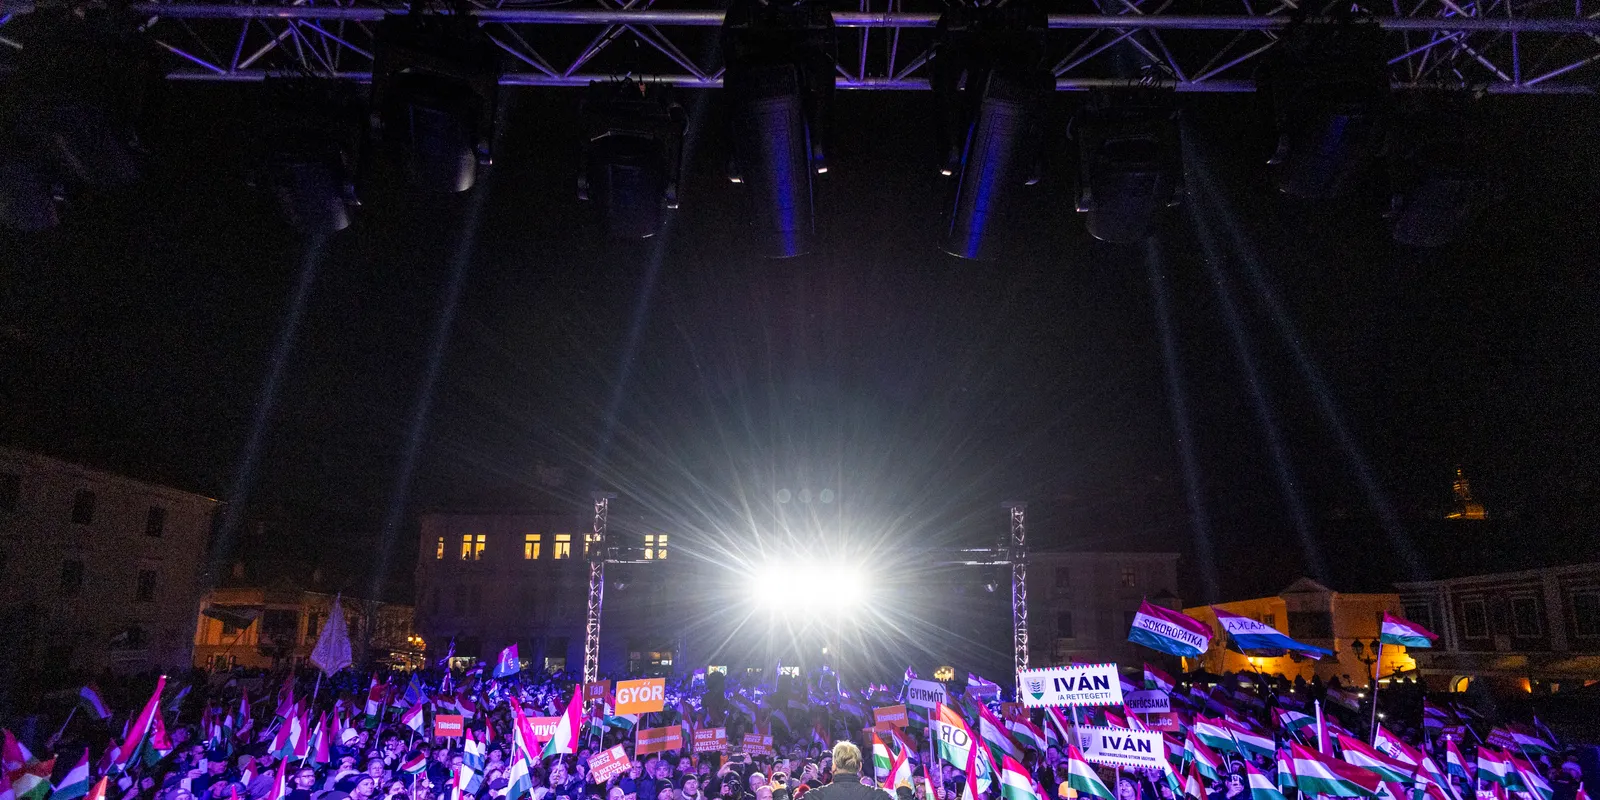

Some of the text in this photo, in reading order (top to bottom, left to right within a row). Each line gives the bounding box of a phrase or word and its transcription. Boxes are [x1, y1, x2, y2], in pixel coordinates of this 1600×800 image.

[590, 684, 604, 697] Táp
[1053, 673, 1110, 692] IVÁN
[617, 682, 664, 704] GYŐR
[910, 687, 943, 703] GYIRMÓT
[1102, 734, 1152, 753] IVÁN
